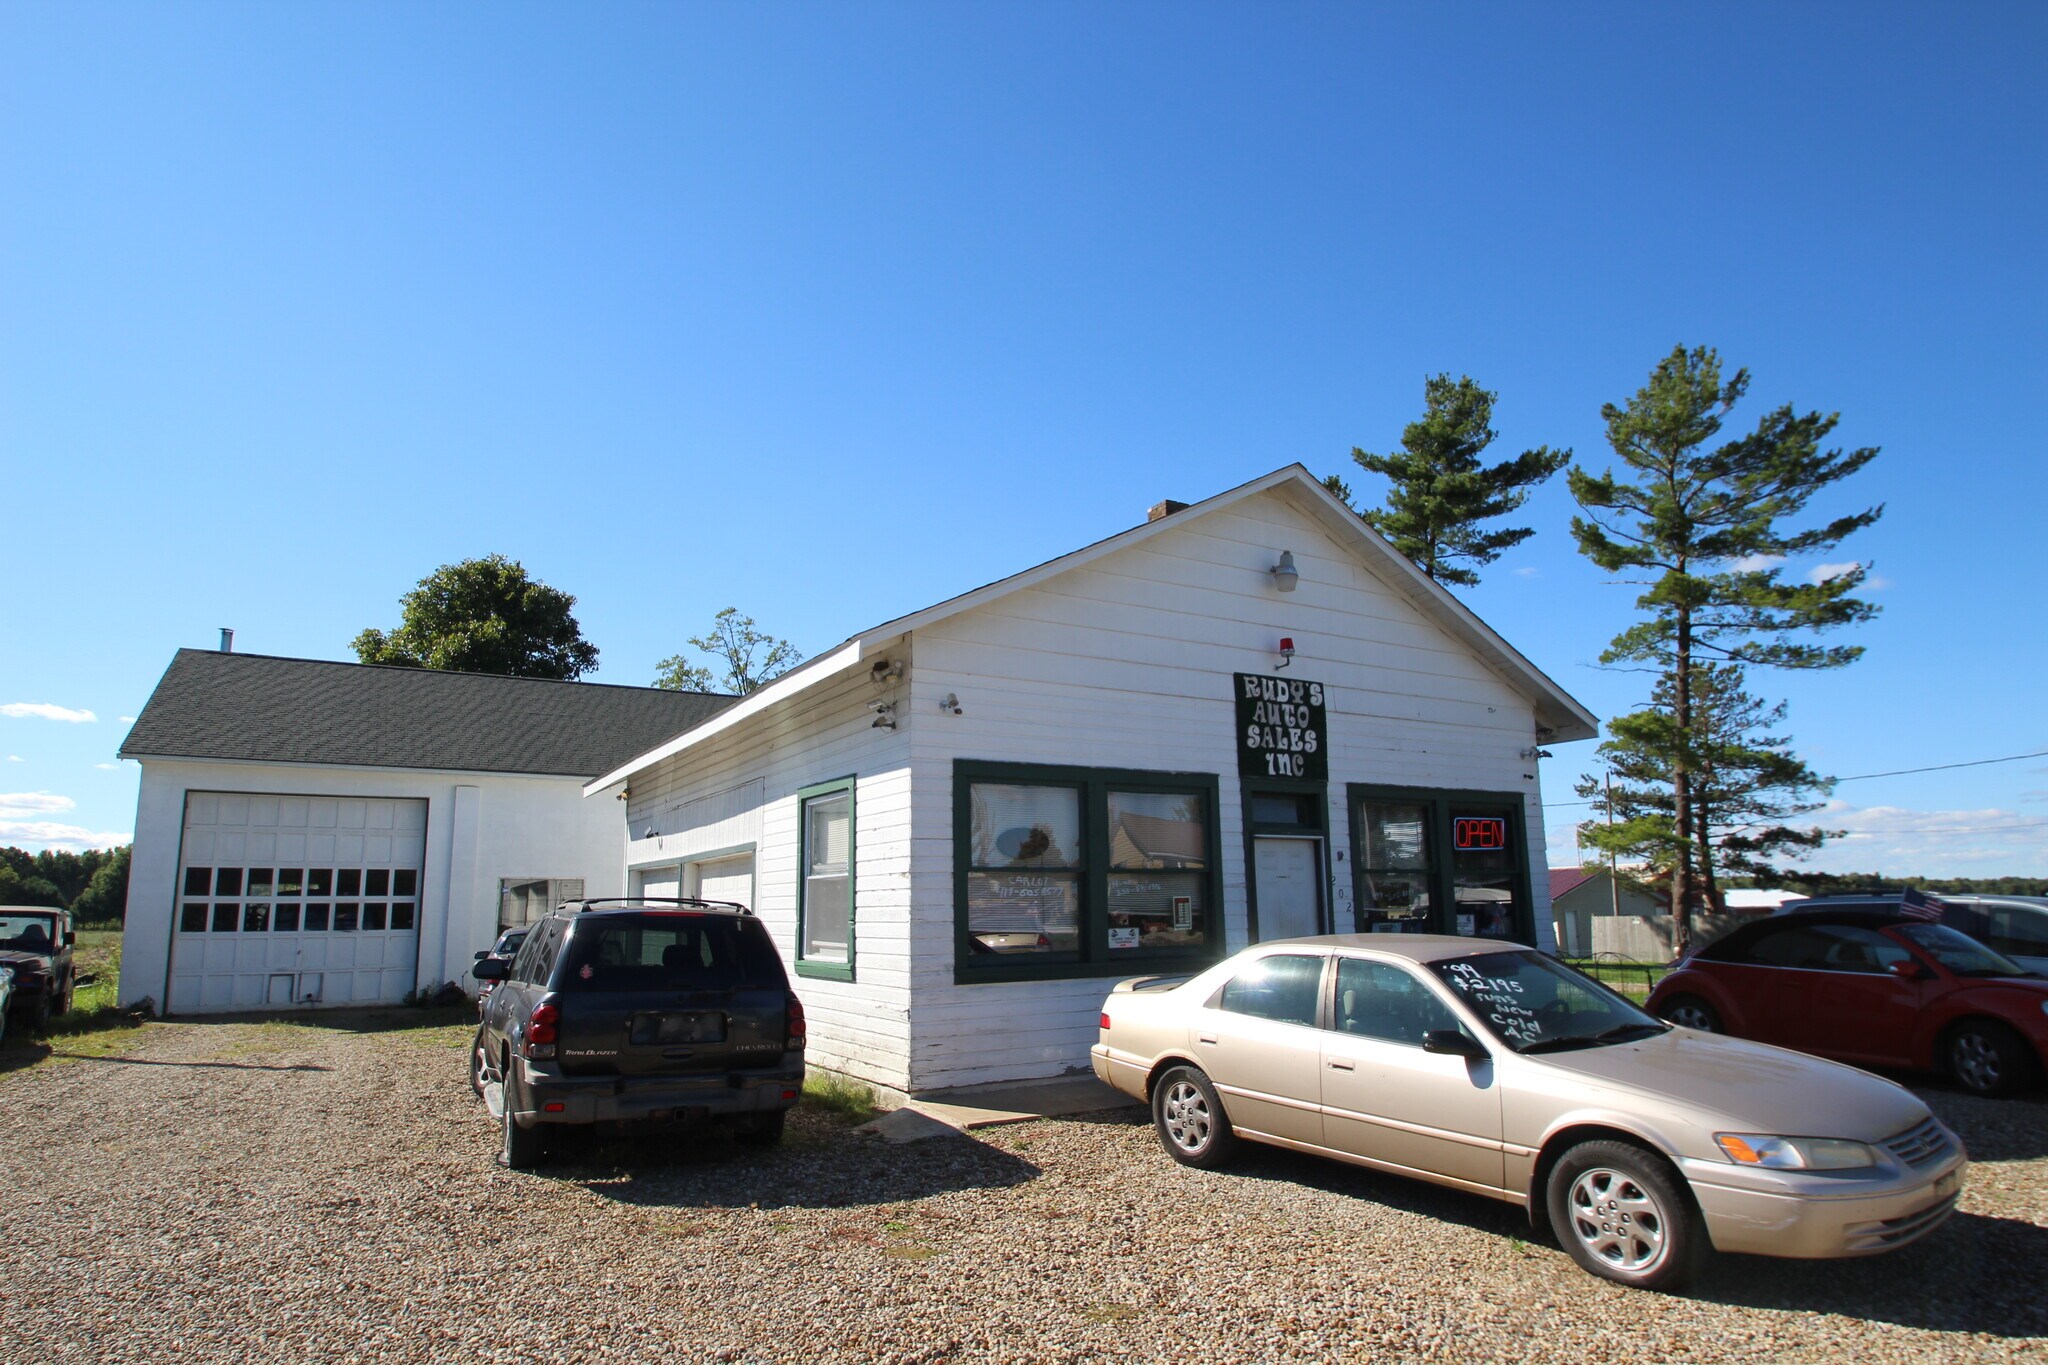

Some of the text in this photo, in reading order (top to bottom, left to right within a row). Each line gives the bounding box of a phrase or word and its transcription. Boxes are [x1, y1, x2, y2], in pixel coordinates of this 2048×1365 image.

[1243, 675, 1323, 706] RUDY'S
[1252, 701, 1310, 729] AUTO
[1246, 724, 1318, 753] SALES
[1265, 752, 1304, 777] INC
[1457, 820, 1503, 847] OPEN
[1453, 975, 1524, 993] $2195
